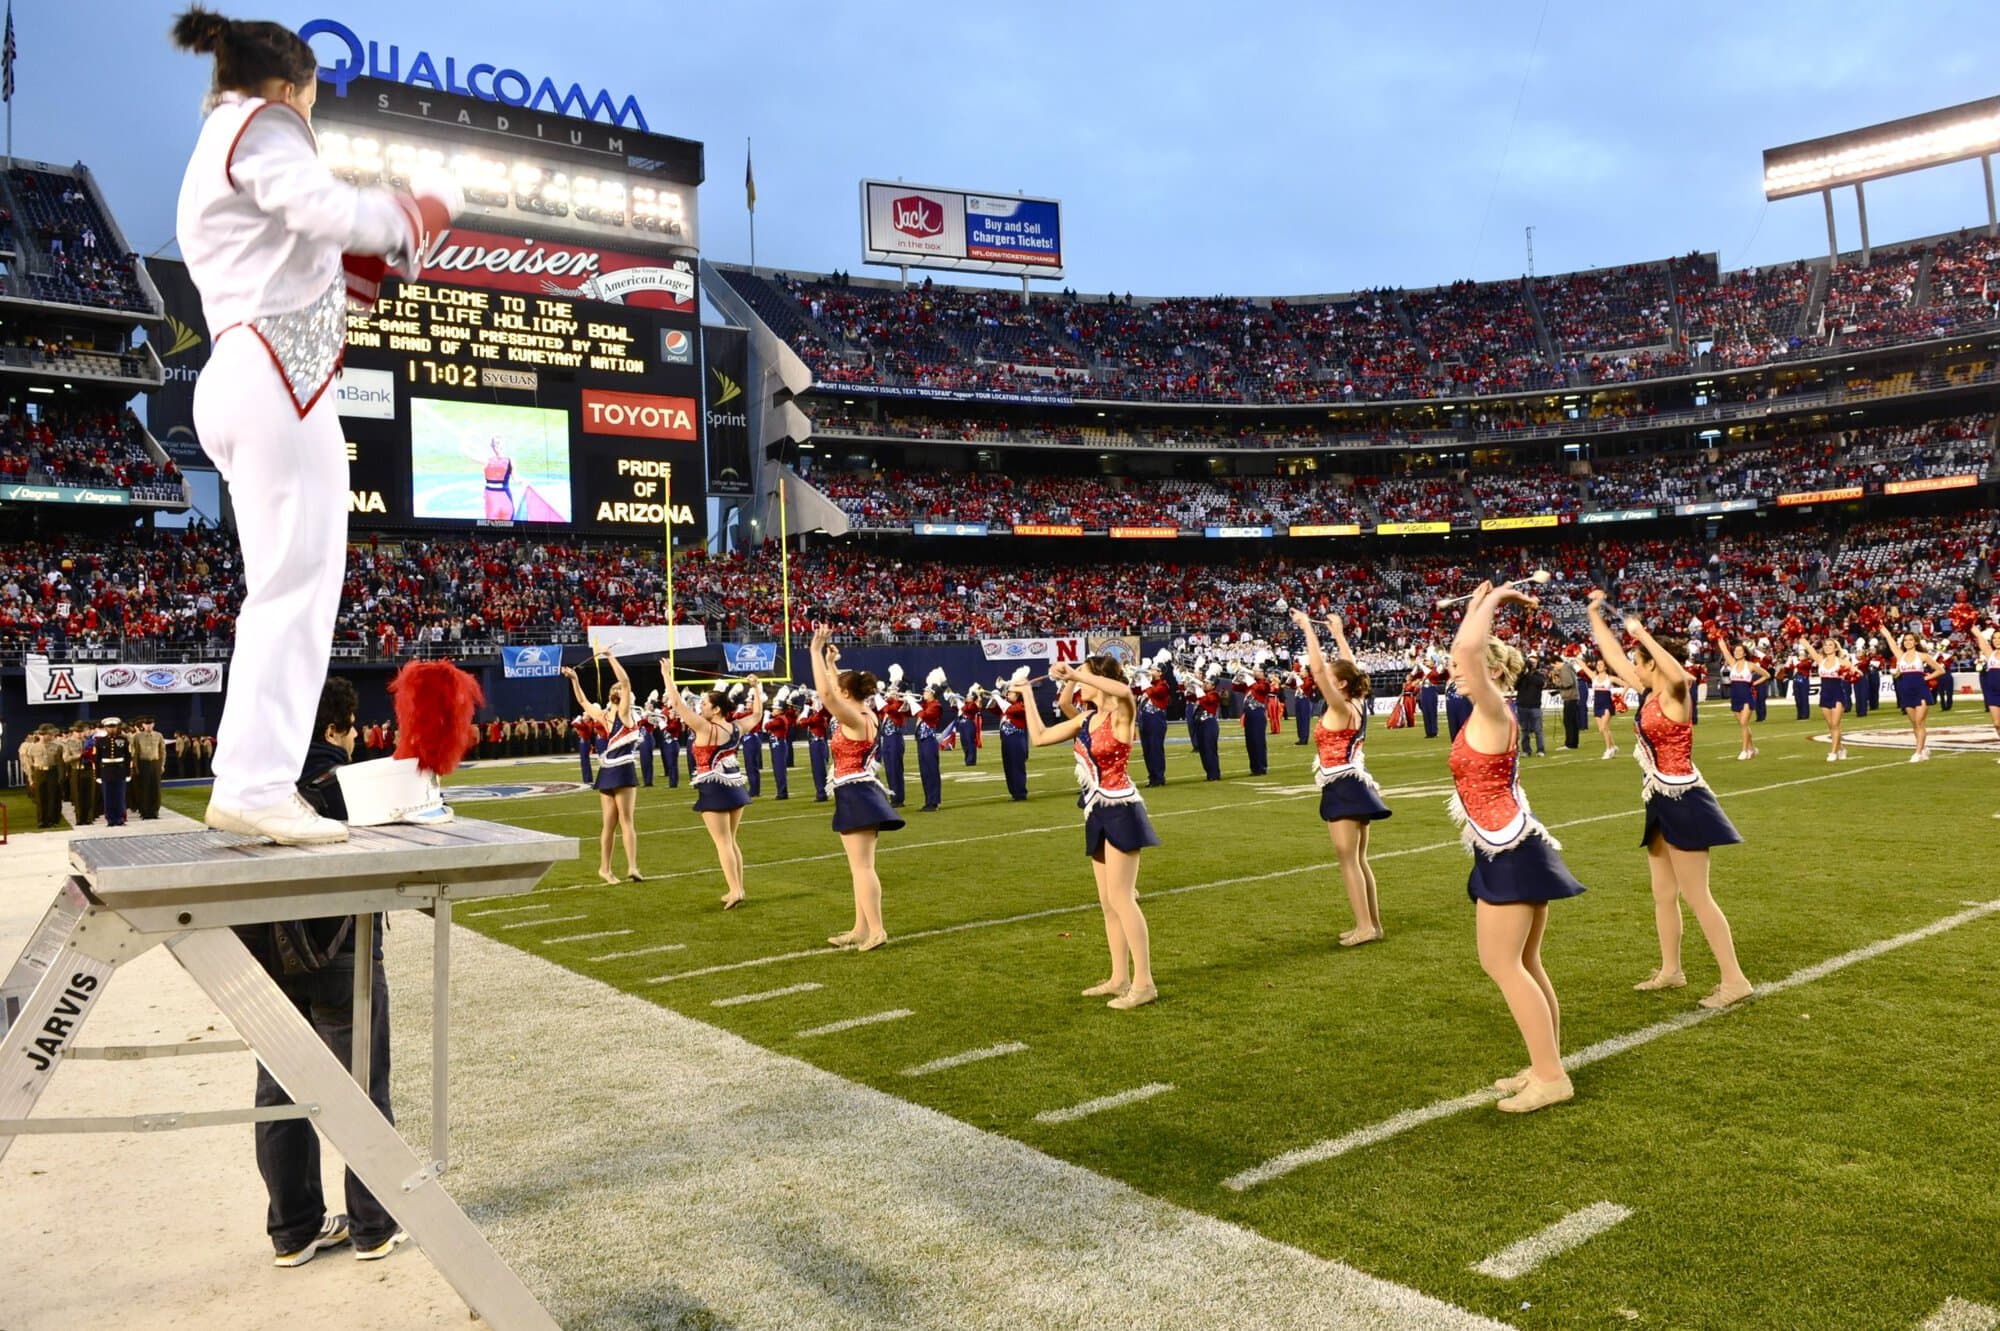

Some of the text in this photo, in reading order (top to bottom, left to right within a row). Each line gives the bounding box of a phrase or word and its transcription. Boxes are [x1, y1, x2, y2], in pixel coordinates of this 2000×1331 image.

[298, 19, 650, 133] QUALCOMM
[378, 94, 624, 153] STADIUM
[895, 200, 943, 233] Jack
[985, 218, 1041, 234] Buy and Sell
[898, 239, 941, 250] in the box
[973, 230, 1054, 249] Chargers Tickets!
[386, 230, 599, 278] weiser
[604, 274, 691, 294] American Lager
[398, 283, 573, 319] WELCOME TO THE
[430, 305, 483, 326] LIFE
[494, 312, 579, 336] HOLIDAY
[588, 323, 635, 343] BOWL
[345, 315, 627, 357] RE-GAME SHOW PRESENTED BY THE
[345, 331, 645, 374] UAN BAND OF THE KUMEYAAY NATION
[164, 364, 200, 383] prin
[408, 359, 478, 388] 17:02
[483, 371, 537, 387] SYCUAN
[336, 386, 391, 404] nBank
[838, 383, 851, 391] FAN
[851, 384, 879, 393] CONDUCT
[975, 392, 991, 400] YOUR
[991, 393, 1020, 402] LOCATION
[588, 402, 692, 431] TOYOTA
[706, 410, 747, 428] Sprint
[617, 459, 671, 478] PRIDE
[21, 489, 60, 500] Degree
[85, 492, 122, 504] Degree
[633, 482, 657, 498] OF
[1780, 489, 1862, 505] WELLS FARGO
[596, 502, 695, 524] ARIZONA
[1590, 514, 1614, 522] Degree
[1628, 510, 1652, 519] Degree
[1016, 526, 1082, 535] WELLS FARGO
[1056, 640, 1079, 662] N
[504, 664, 560, 678] PACIFIC LIF
[44, 667, 83, 701] A
[26, 971, 98, 1072] JARVIS
